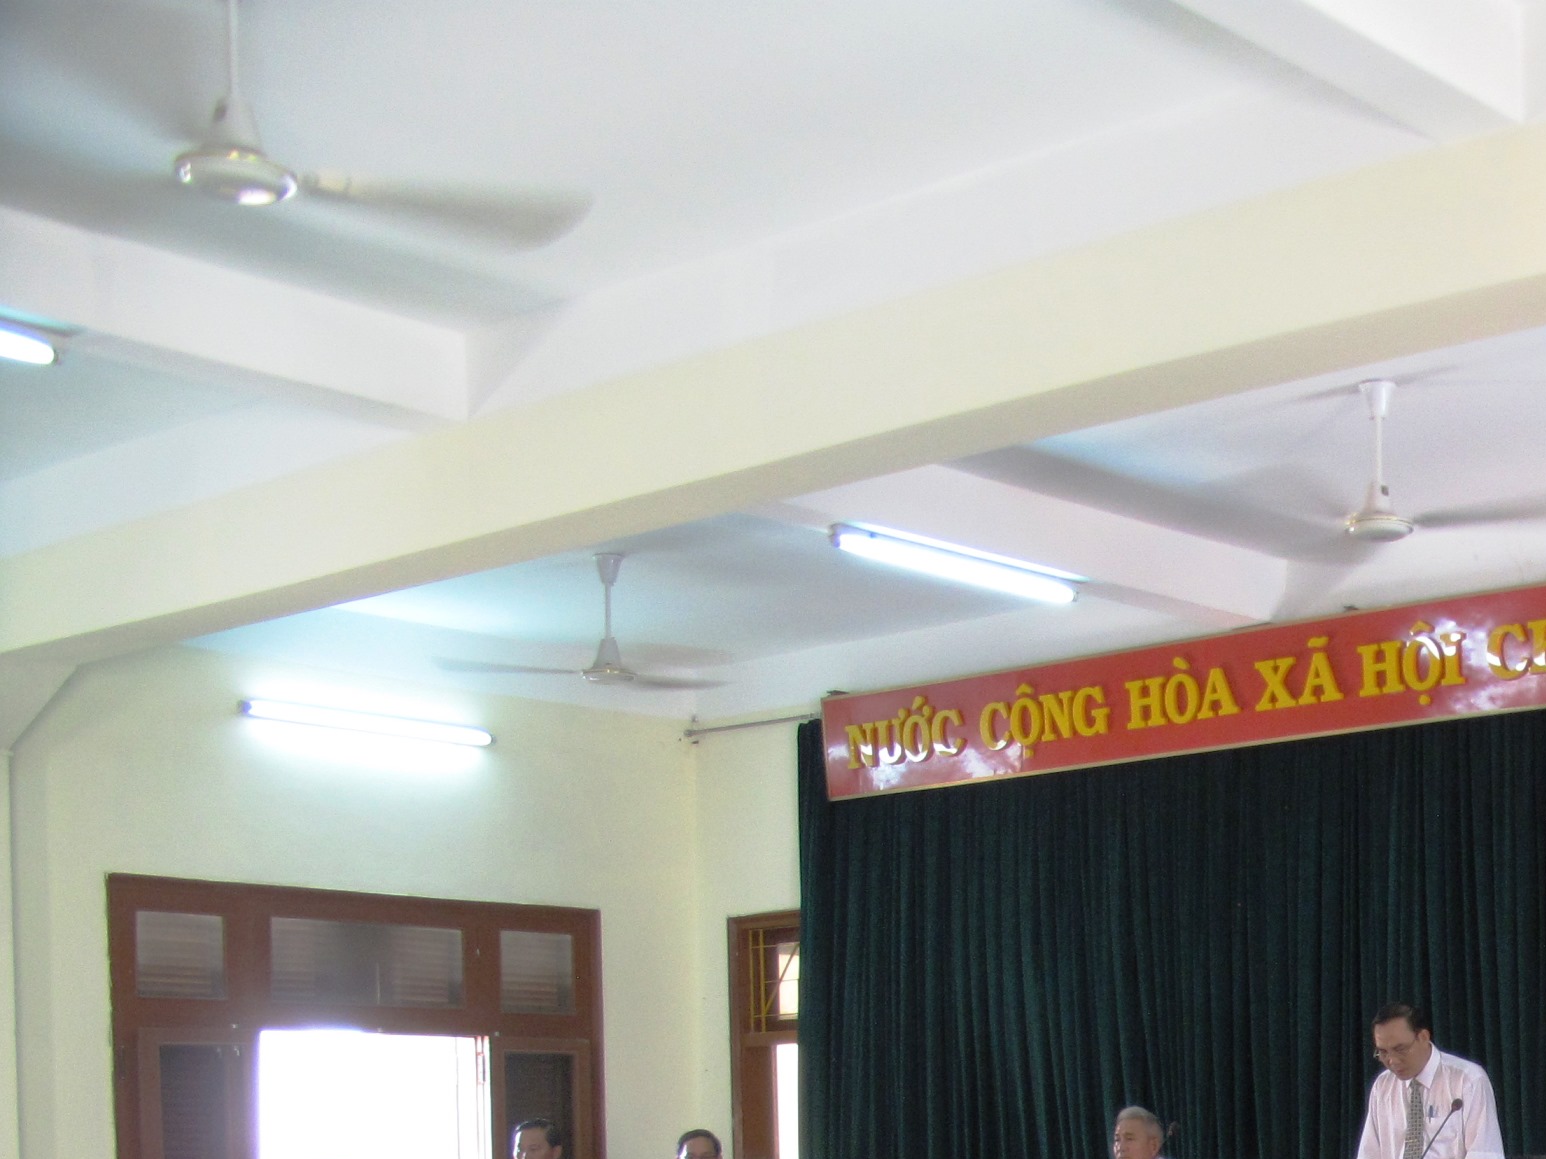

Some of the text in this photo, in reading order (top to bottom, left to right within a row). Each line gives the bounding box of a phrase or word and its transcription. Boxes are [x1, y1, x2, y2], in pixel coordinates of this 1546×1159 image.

[845, 694, 966, 771] NƯỚC
[979, 682, 1110, 758] CỘNG
[1127, 657, 1237, 731] HÒA
[1254, 635, 1343, 712] XÃ
[1357, 620, 1467, 706] HỘI
